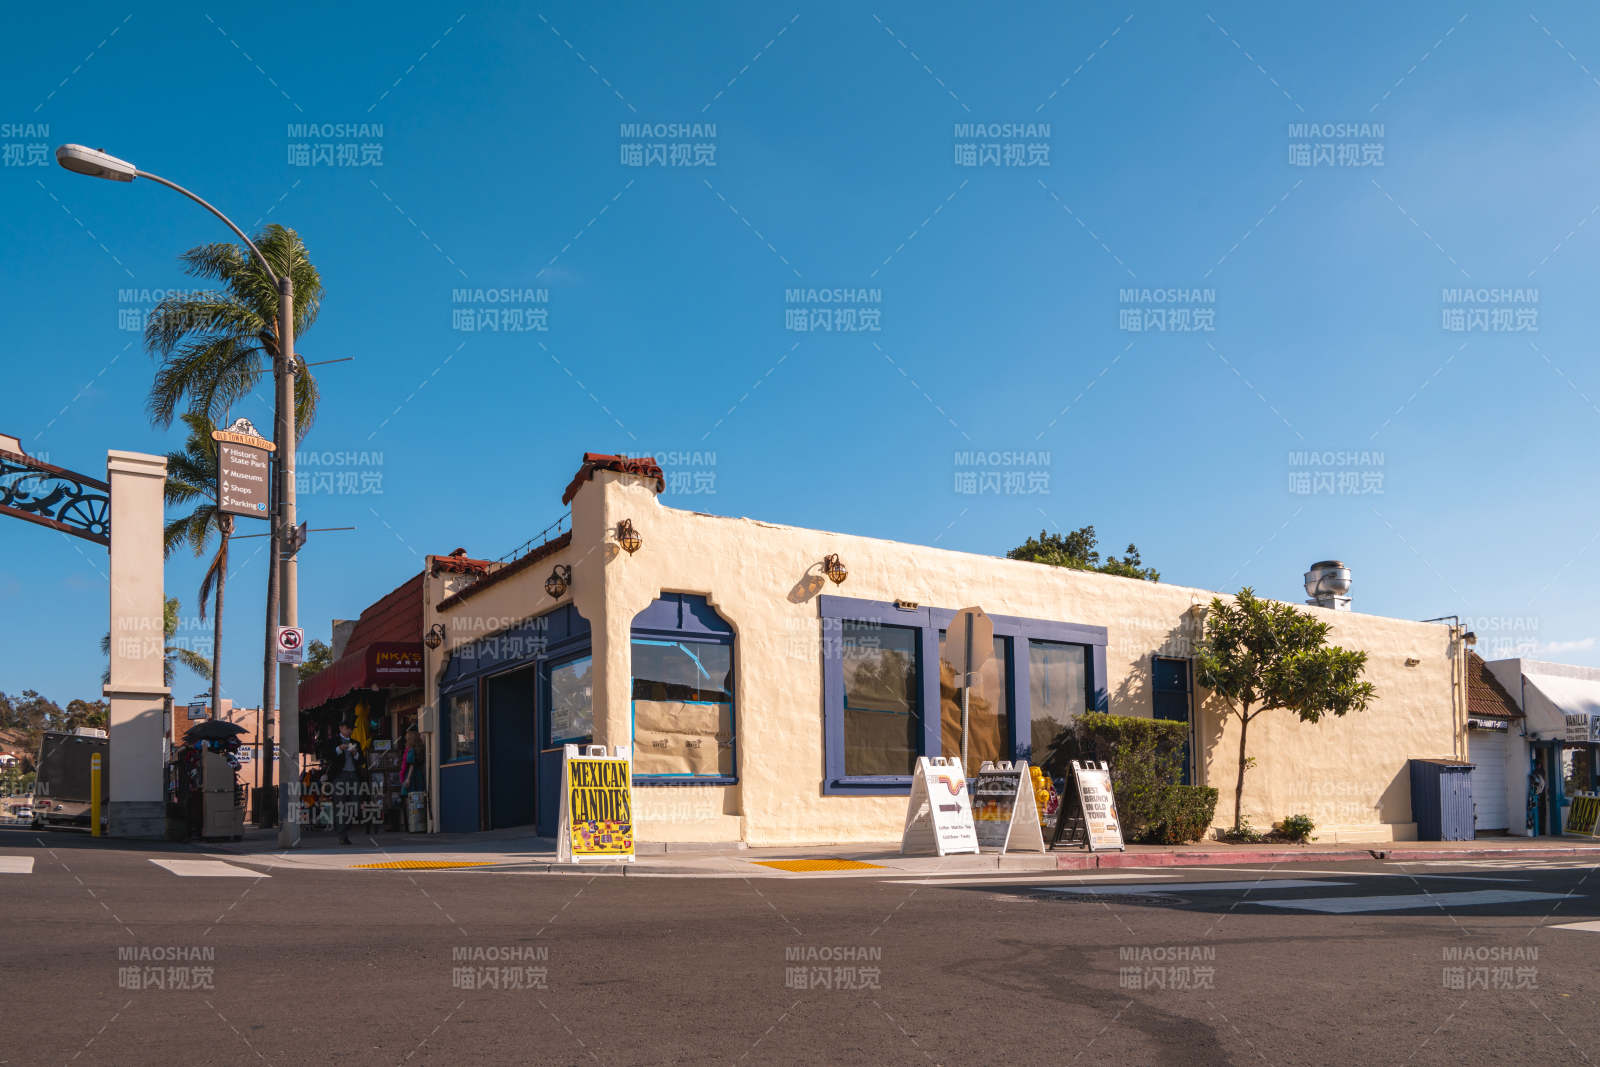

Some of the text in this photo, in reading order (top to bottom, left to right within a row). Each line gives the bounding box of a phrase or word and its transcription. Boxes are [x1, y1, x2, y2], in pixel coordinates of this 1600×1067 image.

[230, 449, 257, 459] Historic
[230, 456, 266, 468] State Park
[230, 471, 263, 482] Museums
[230, 484, 252, 494] Shops
[230, 499, 257, 510] Parking
[570, 761, 627, 788] MEXICAN
[1082, 786, 1098, 794] BEST
[1084, 794, 1109, 802] BRUNCH
[571, 788, 630, 824] CANDIES
[1085, 803, 1094, 811] IN
